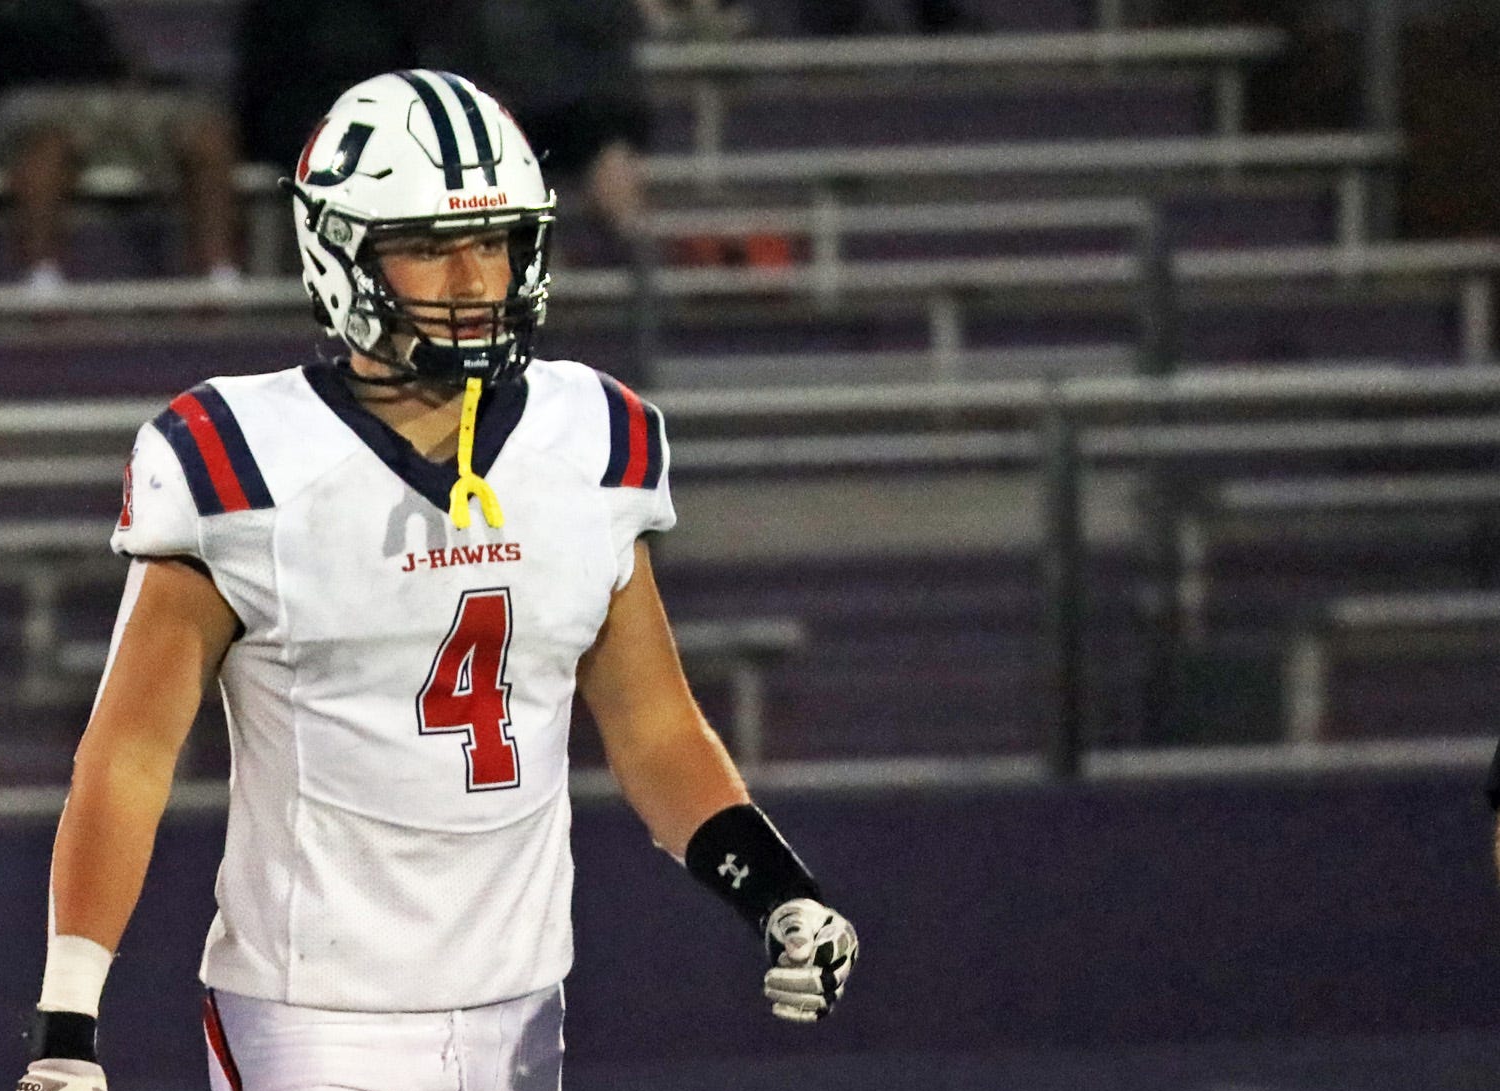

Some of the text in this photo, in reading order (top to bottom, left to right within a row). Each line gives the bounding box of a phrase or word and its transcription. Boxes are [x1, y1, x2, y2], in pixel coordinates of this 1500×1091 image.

[449, 192, 507, 209] Riddell
[402, 542, 521, 572] J-HAWKS
[417, 586, 520, 793] 4
